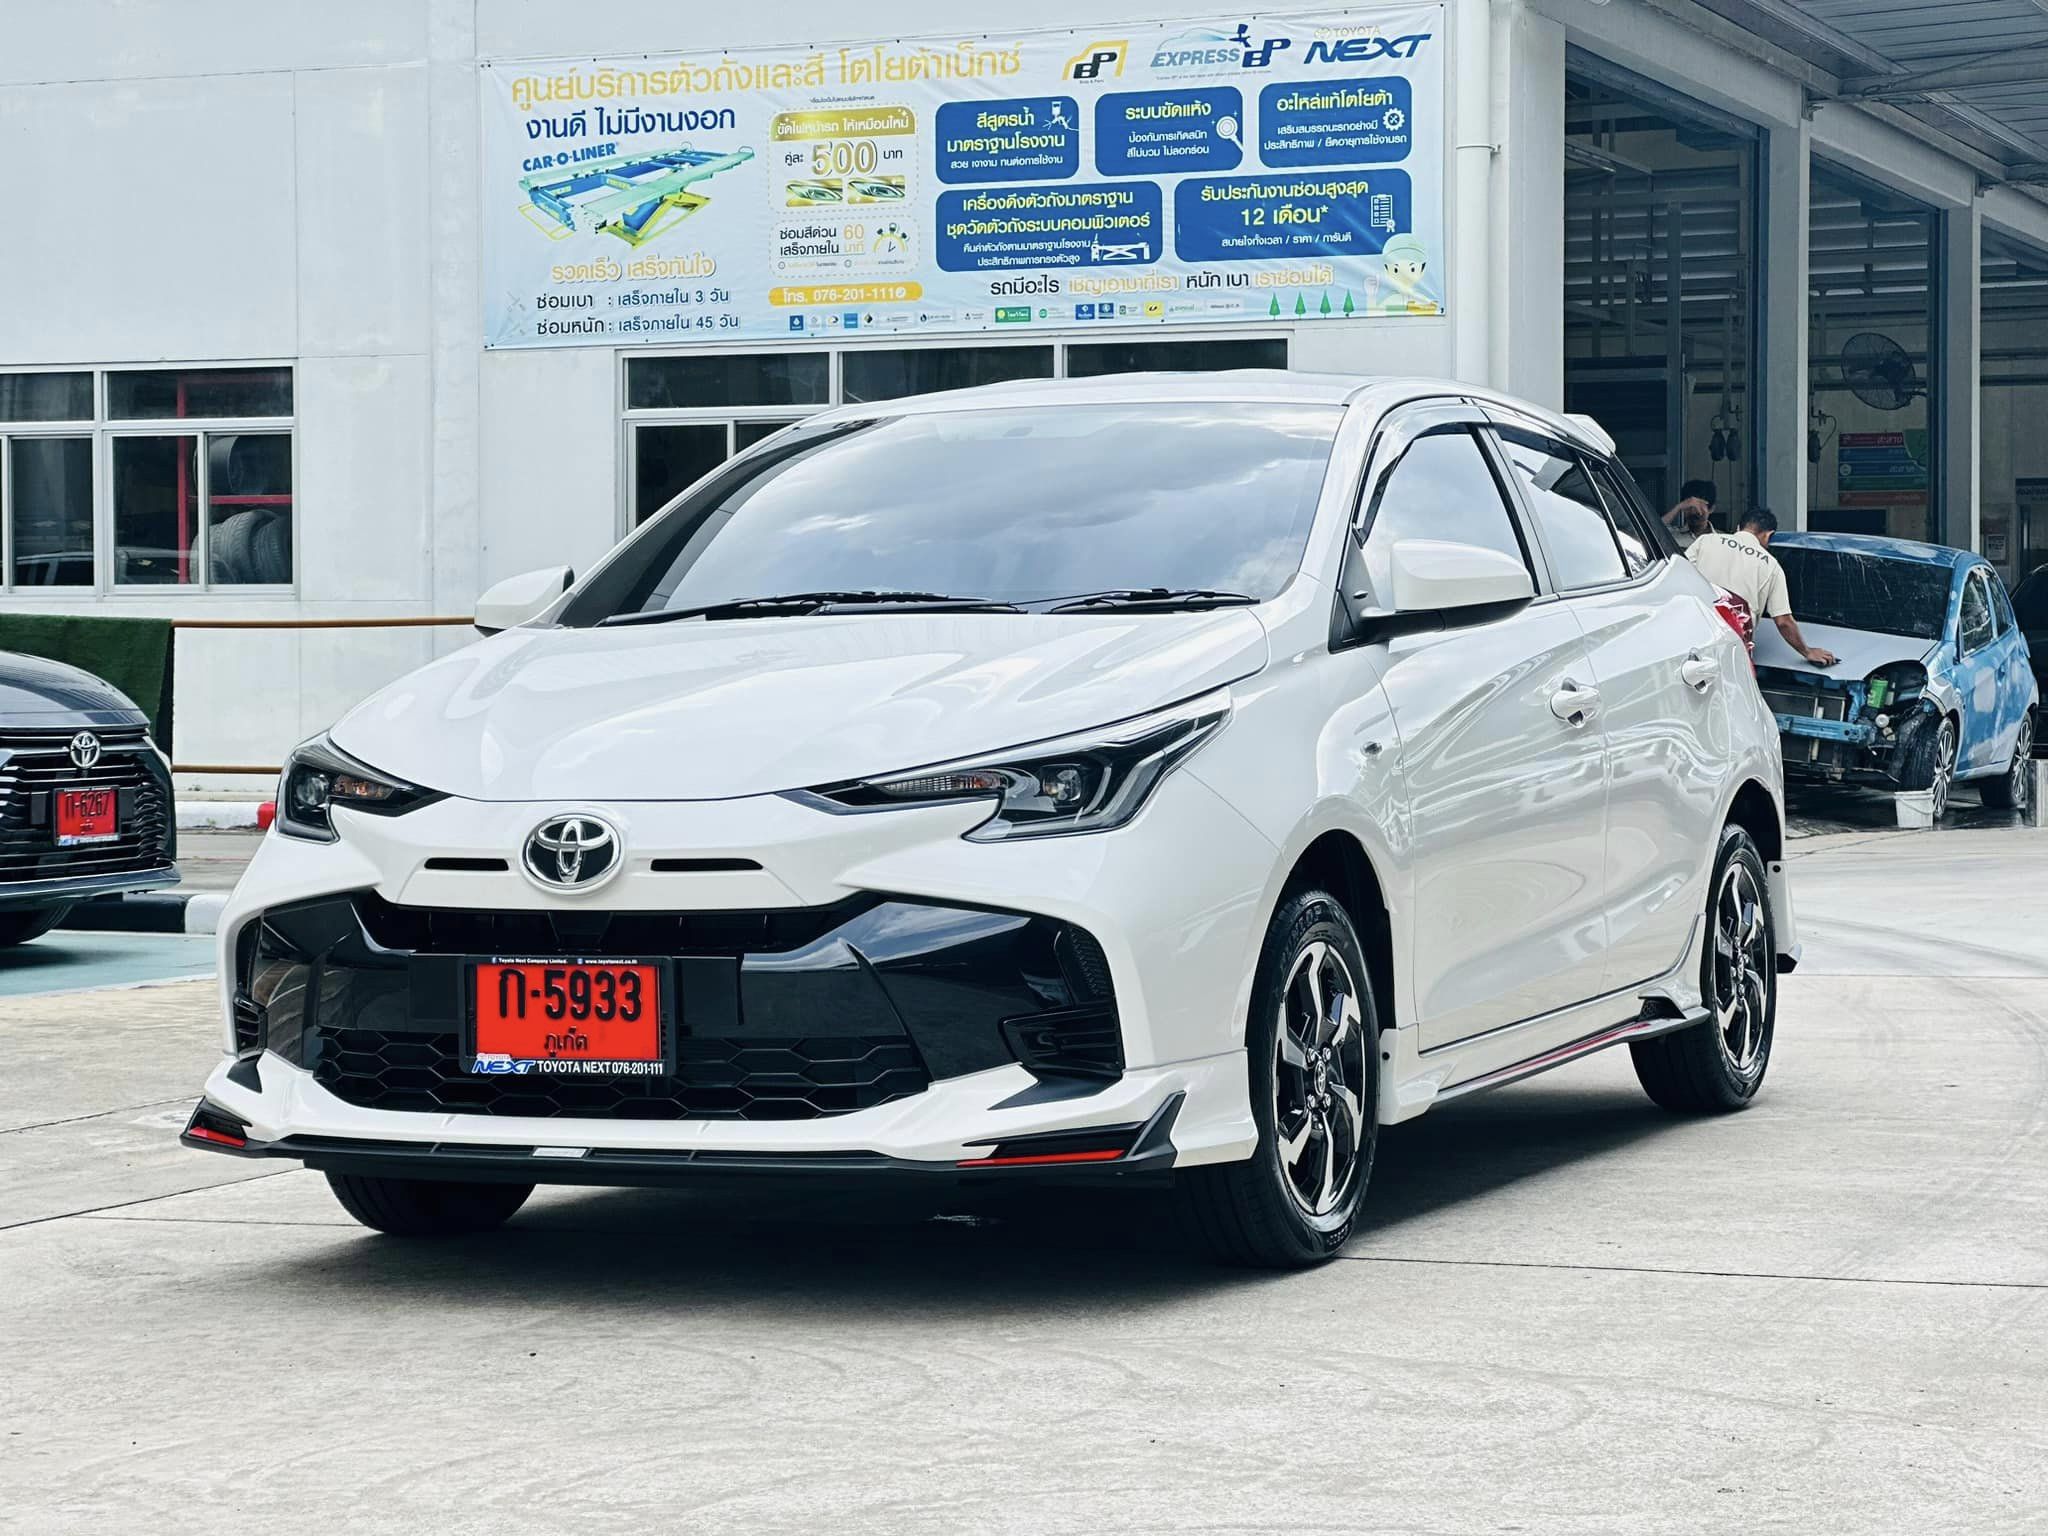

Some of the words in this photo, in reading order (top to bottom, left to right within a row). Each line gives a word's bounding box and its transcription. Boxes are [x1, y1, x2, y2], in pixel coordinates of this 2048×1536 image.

[1333, 25, 1382, 38] TOYOTA
[1150, 48, 1240, 68] EXPRESS
[1303, 34, 1432, 65] NEXT
[512, 54, 824, 111] ศูนย์บริการตัวถังและสี
[526, 109, 586, 139] งานดี
[595, 106, 736, 136] ไม่มีงานงอก
[812, 140, 877, 176] 500
[883, 149, 904, 161] บาท
[1241, 208, 1265, 226] 12
[843, 224, 865, 241] 60
[552, 256, 622, 284] รวดเร็ว
[627, 252, 717, 281] เสร็จทันใจ
[990, 274, 1060, 296] รถมีอะไร
[1186, 271, 1221, 289] หนัก
[1226, 273, 1249, 287] เบา
[618, 287, 689, 307] เสร็จภายใน
[695, 289, 704, 302] 3
[710, 287, 729, 302] วัน
[618, 314, 690, 333] เสร็จภายใน
[696, 315, 714, 329] 45
[719, 313, 739, 328] วัน
[1720, 536, 1769, 565] TOYOTA
[499, 968, 642, 1022] ก-5933
[544, 1026, 588, 1058] ภูเก็ต
[472, 1059, 536, 1075] NEXT
[537, 1061, 580, 1074] TOYOTA
[582, 1061, 611, 1075] NEXT
[611, 1061, 663, 1076] 076-201-111
